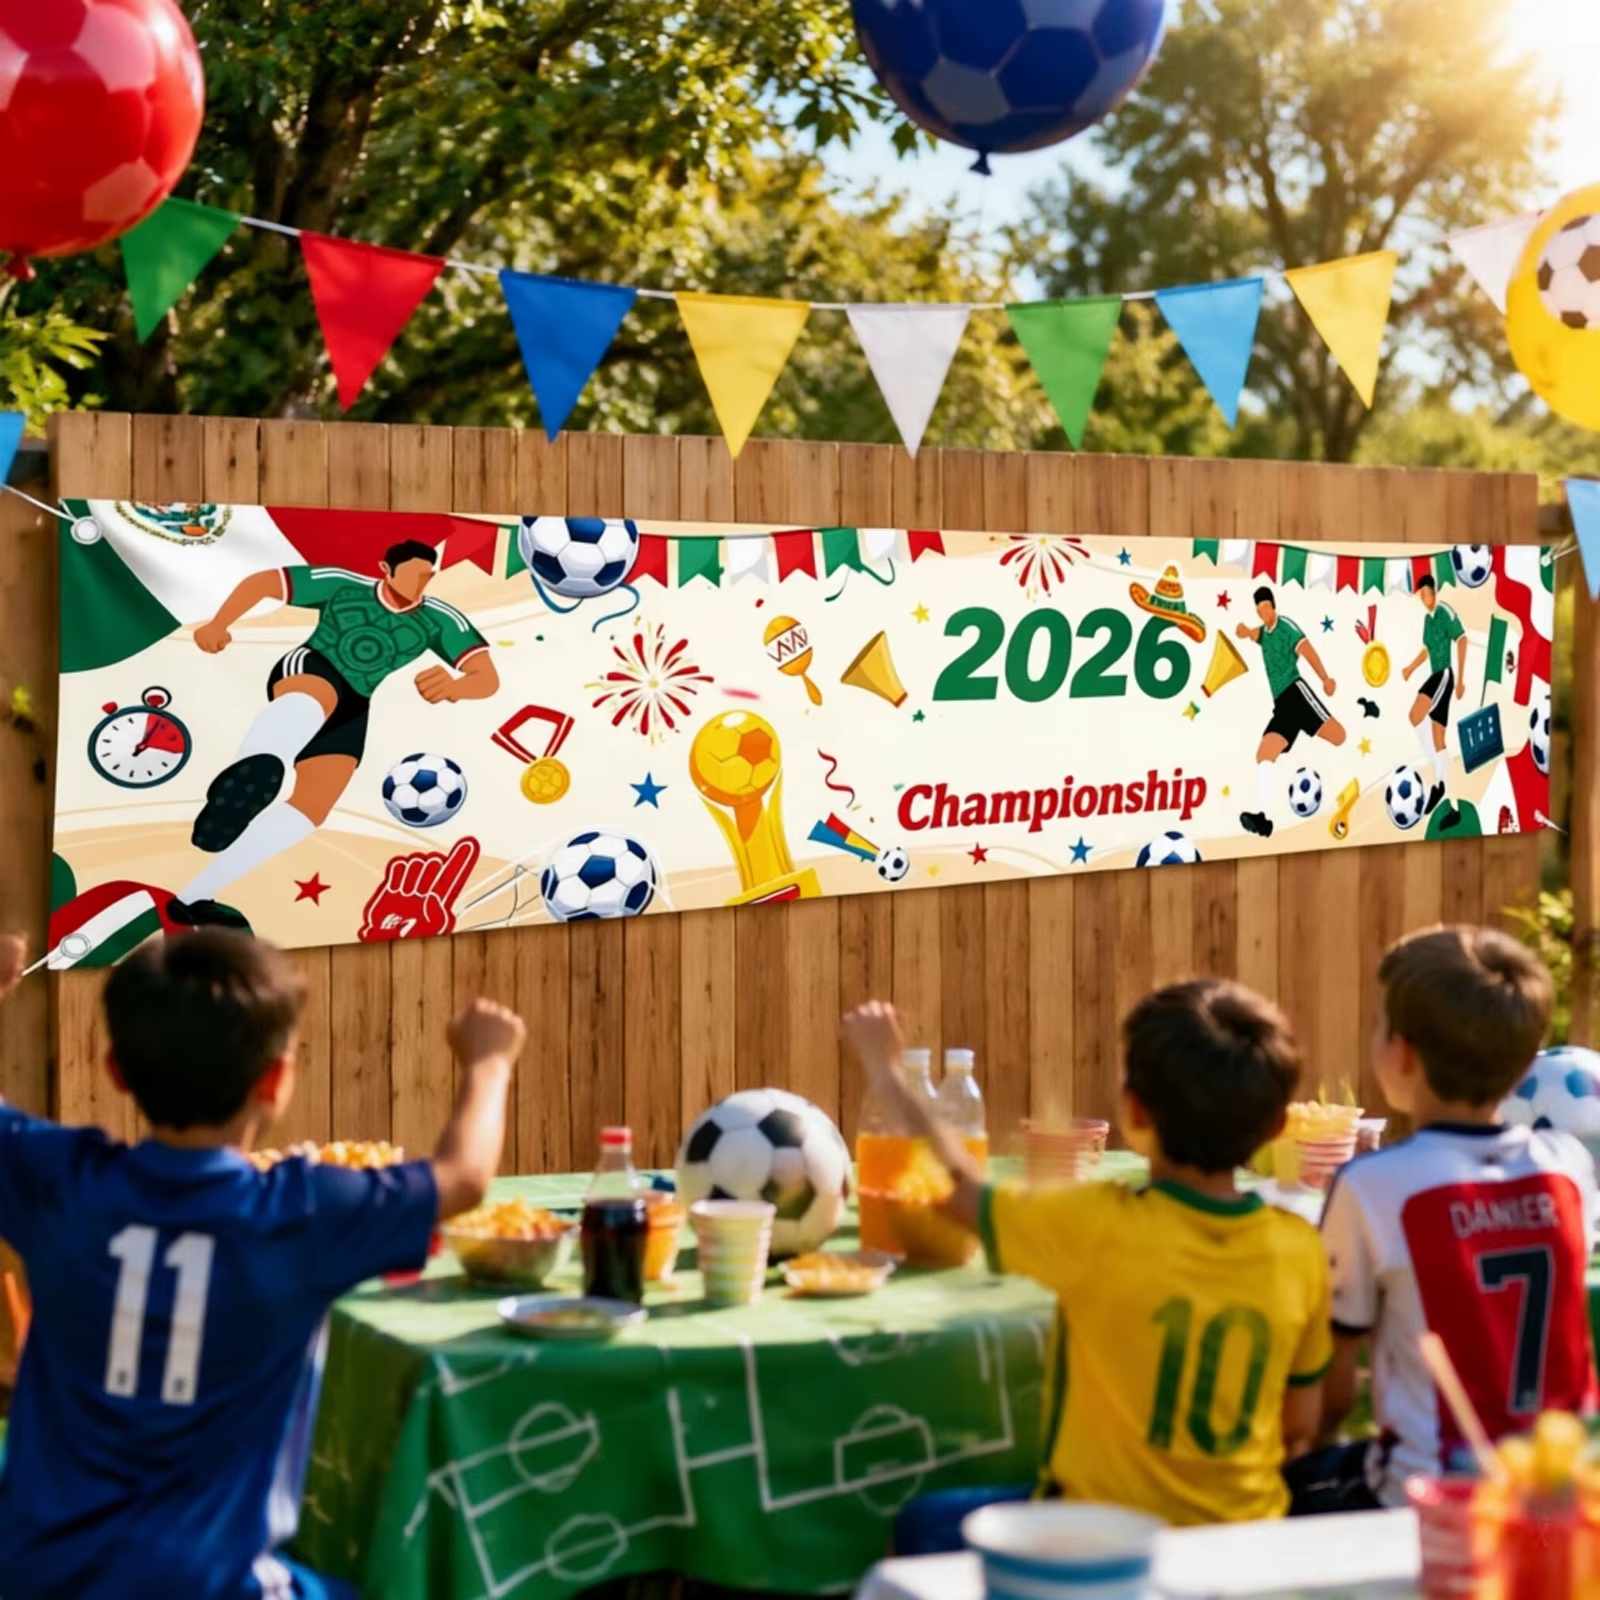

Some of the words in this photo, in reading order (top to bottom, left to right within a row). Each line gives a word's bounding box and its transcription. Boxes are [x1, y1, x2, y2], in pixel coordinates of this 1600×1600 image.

[932, 606, 1191, 702] 2026
[899, 767, 1207, 833] Championship
[105, 1223, 215, 1406] 11
[1147, 1296, 1272, 1458] 10
[1475, 1245, 1555, 1415] 7
